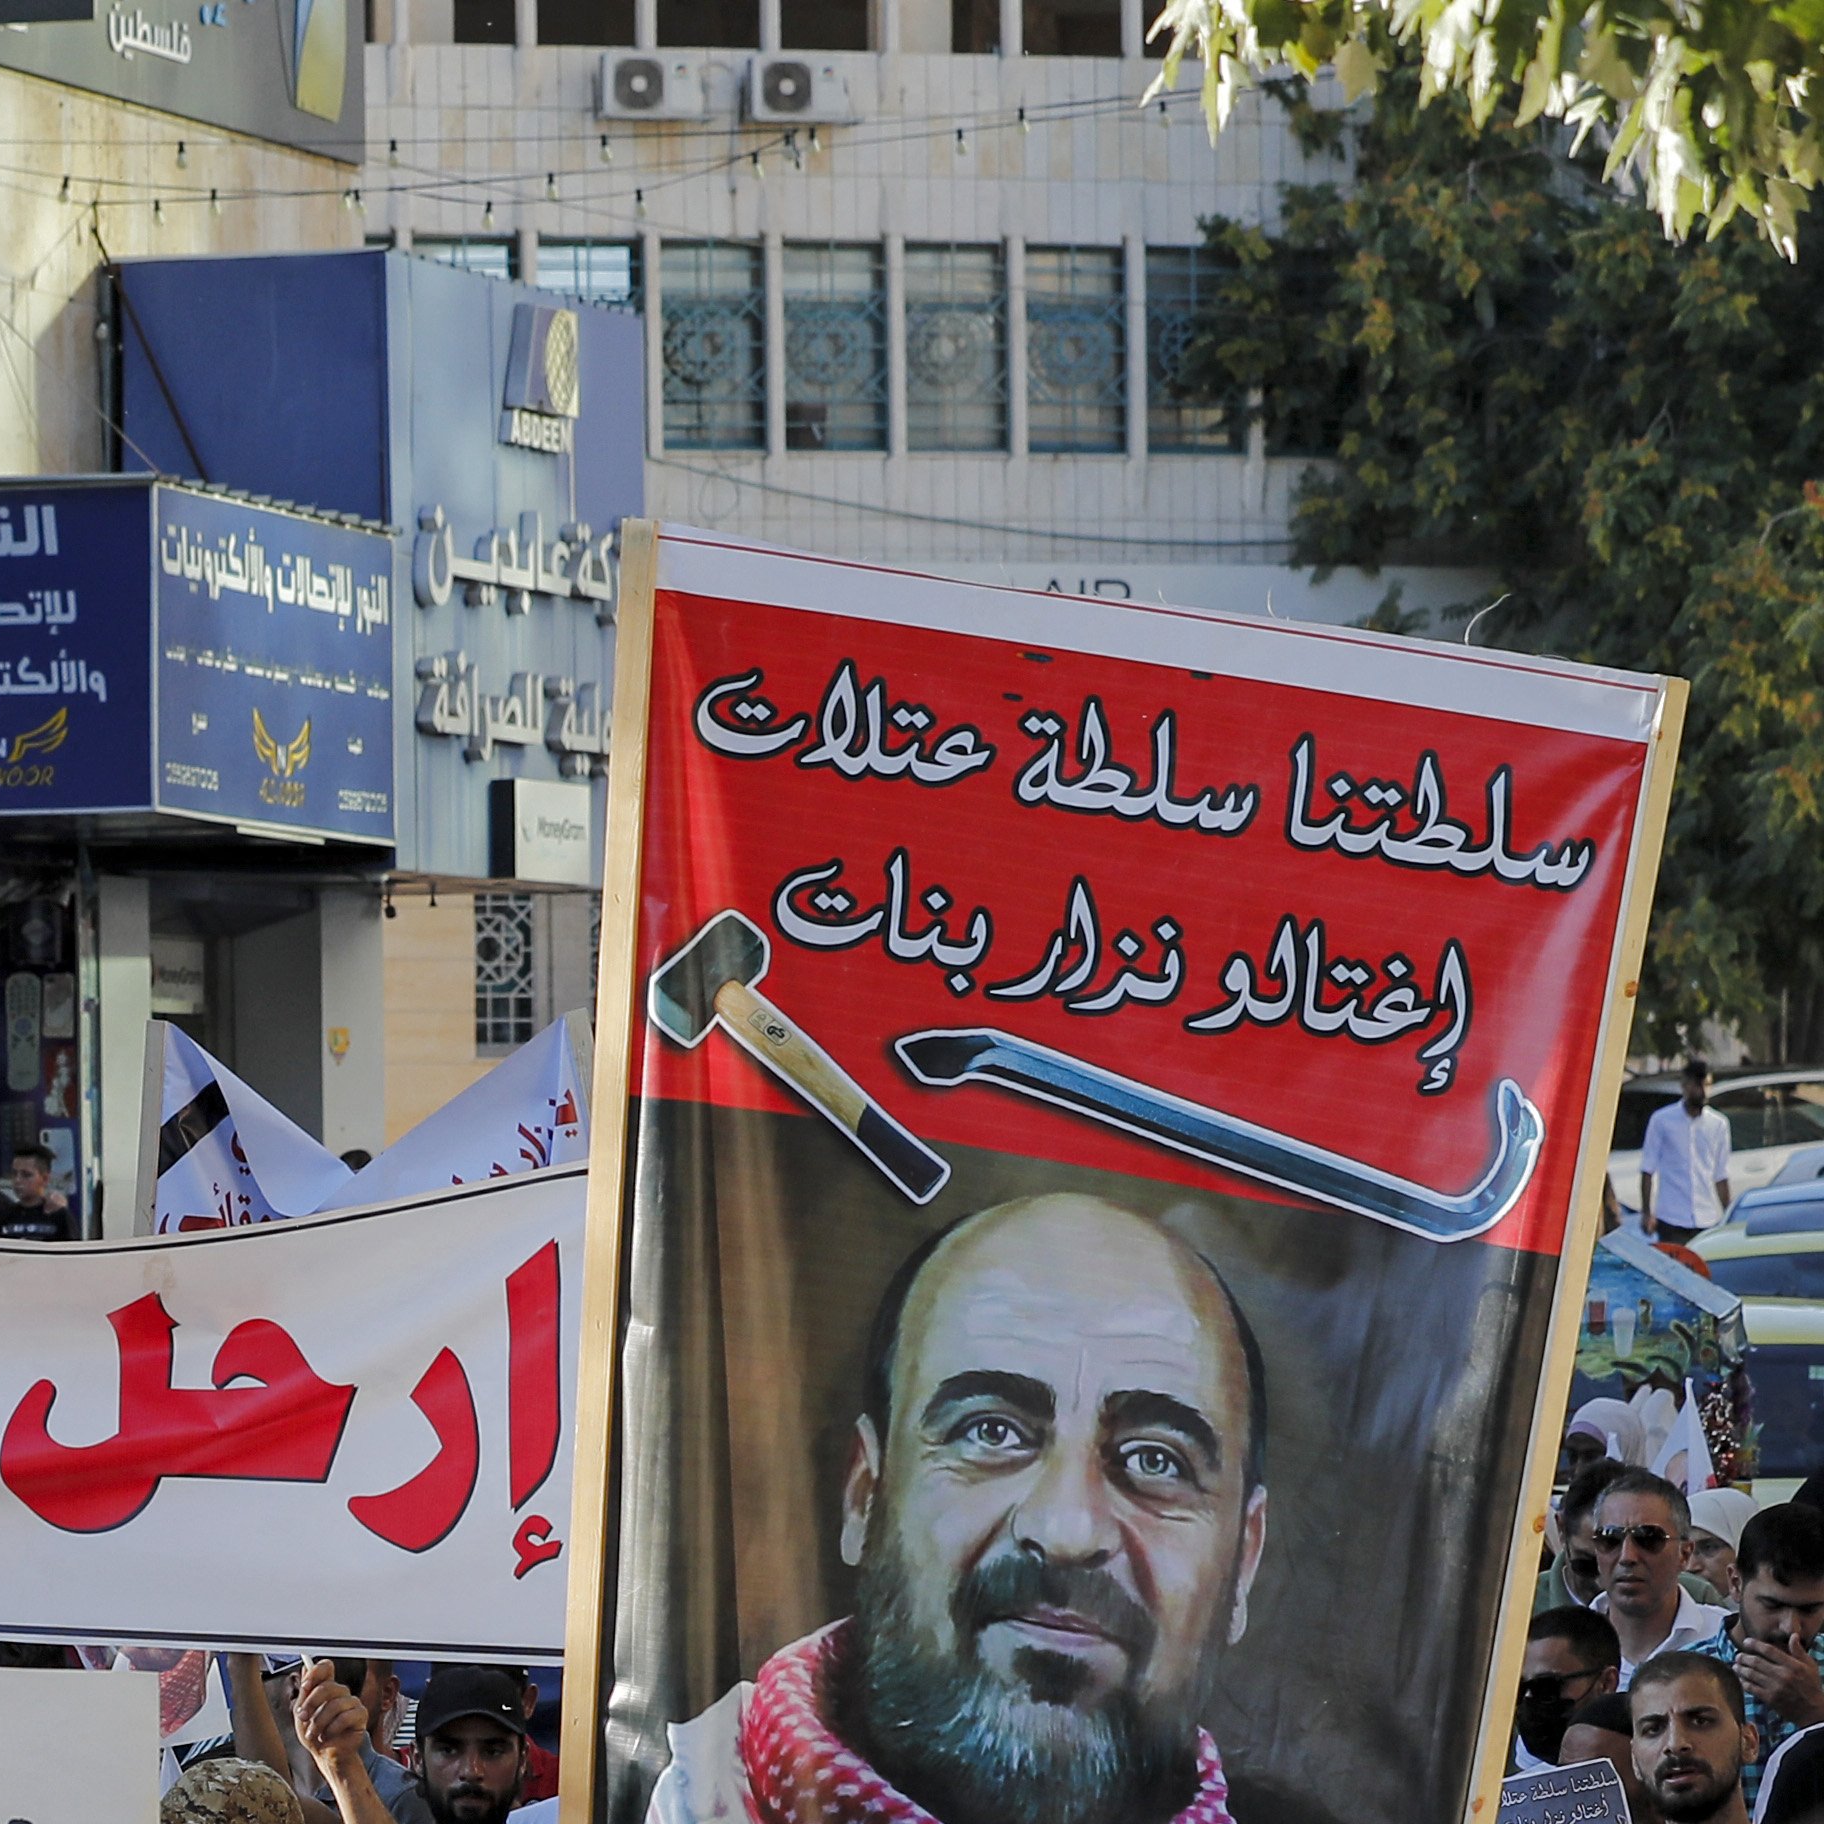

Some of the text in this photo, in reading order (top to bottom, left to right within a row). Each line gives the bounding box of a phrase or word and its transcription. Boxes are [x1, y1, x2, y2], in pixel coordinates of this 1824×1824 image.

[108, 4, 192, 63] فلسطين
[510, 409, 575, 455] ABDEEN
[429, 504, 573, 616] عابدين
[356, 574, 389, 636] النور
[432, 649, 545, 763] للصرافة
[695, 662, 1591, 889] سلطتنا سلطة عتلات
[774, 852, 1468, 1092] إغتالو نزار بنات
[1501, 1771, 1618, 1808] سلطتنا سلطة عتلا
